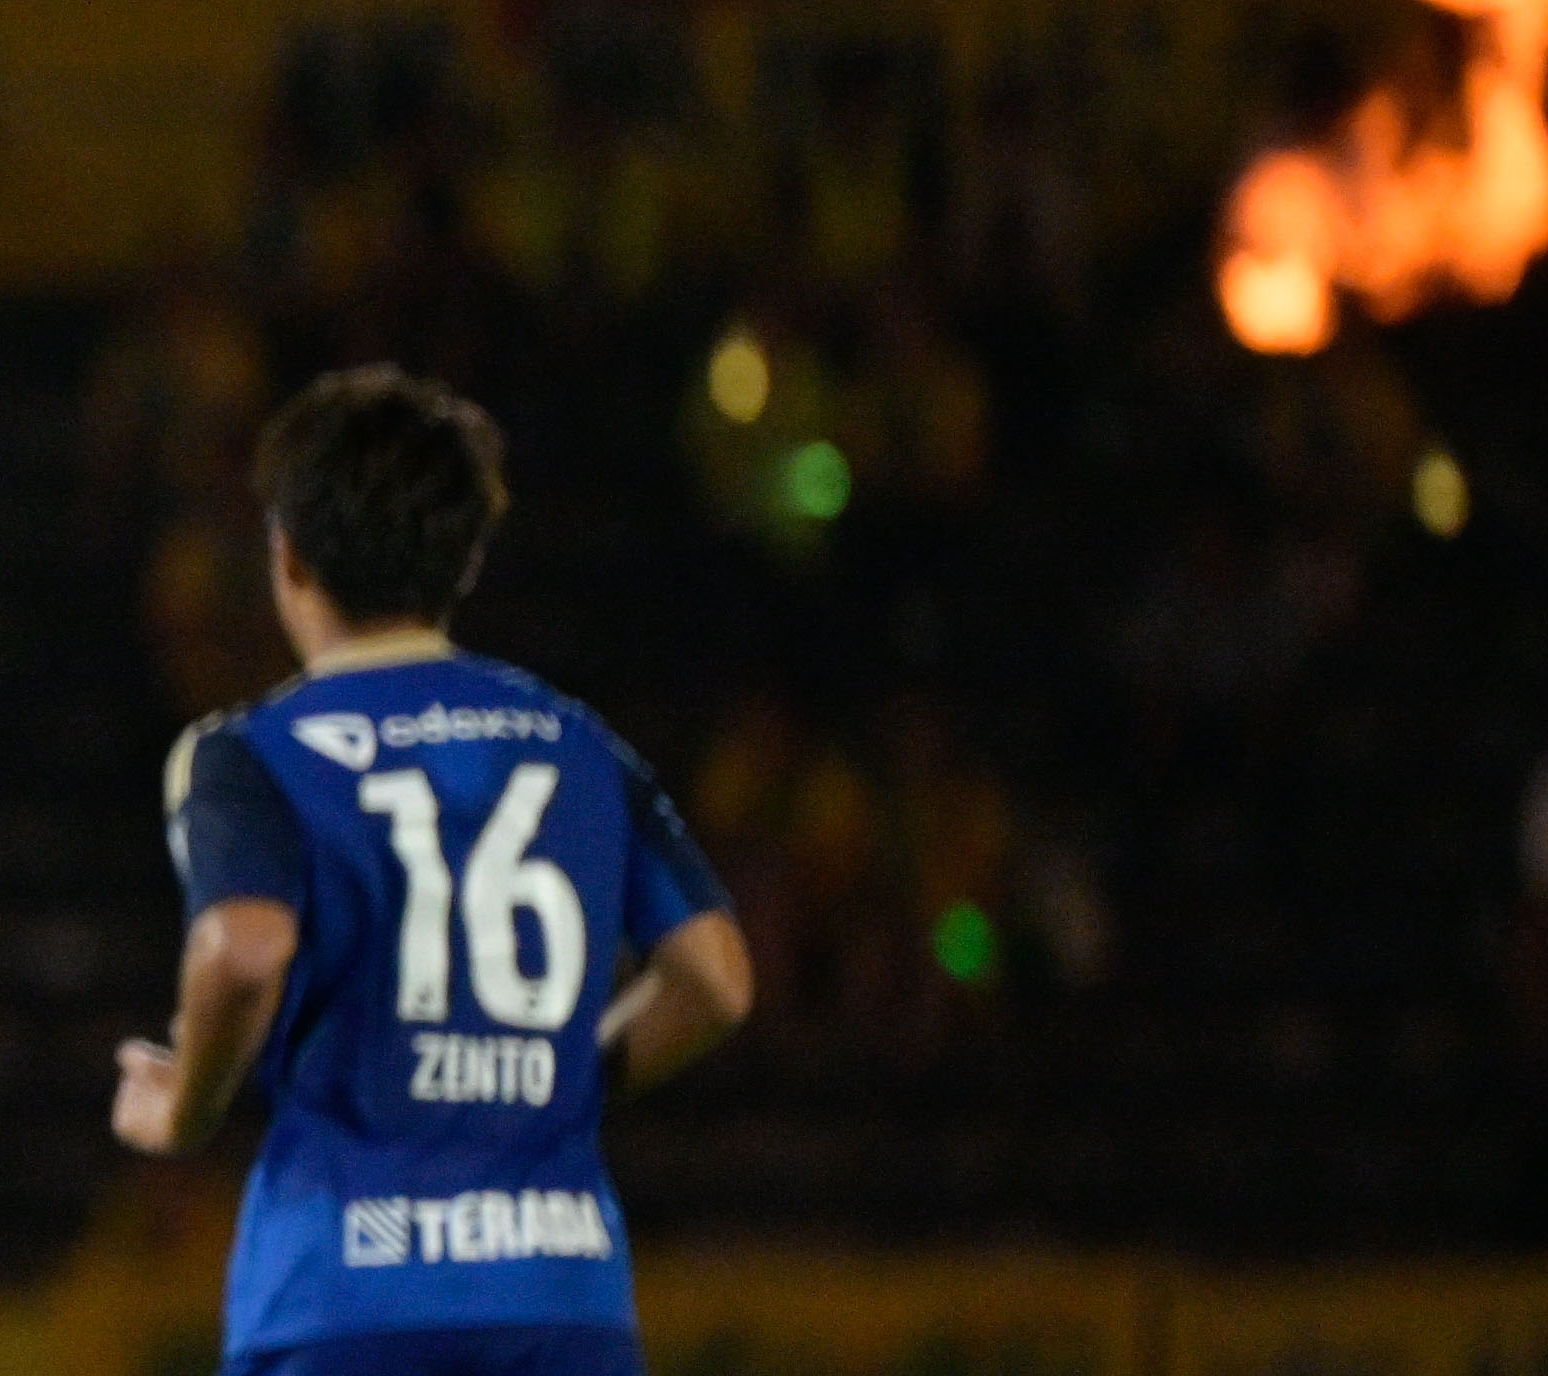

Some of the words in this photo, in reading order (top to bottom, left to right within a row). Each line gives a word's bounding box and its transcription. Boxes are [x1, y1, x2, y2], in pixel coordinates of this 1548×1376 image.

[358, 761, 589, 1033] 16
[410, 1032, 557, 1108] ZENTO
[411, 1188, 614, 1264] TERADA
